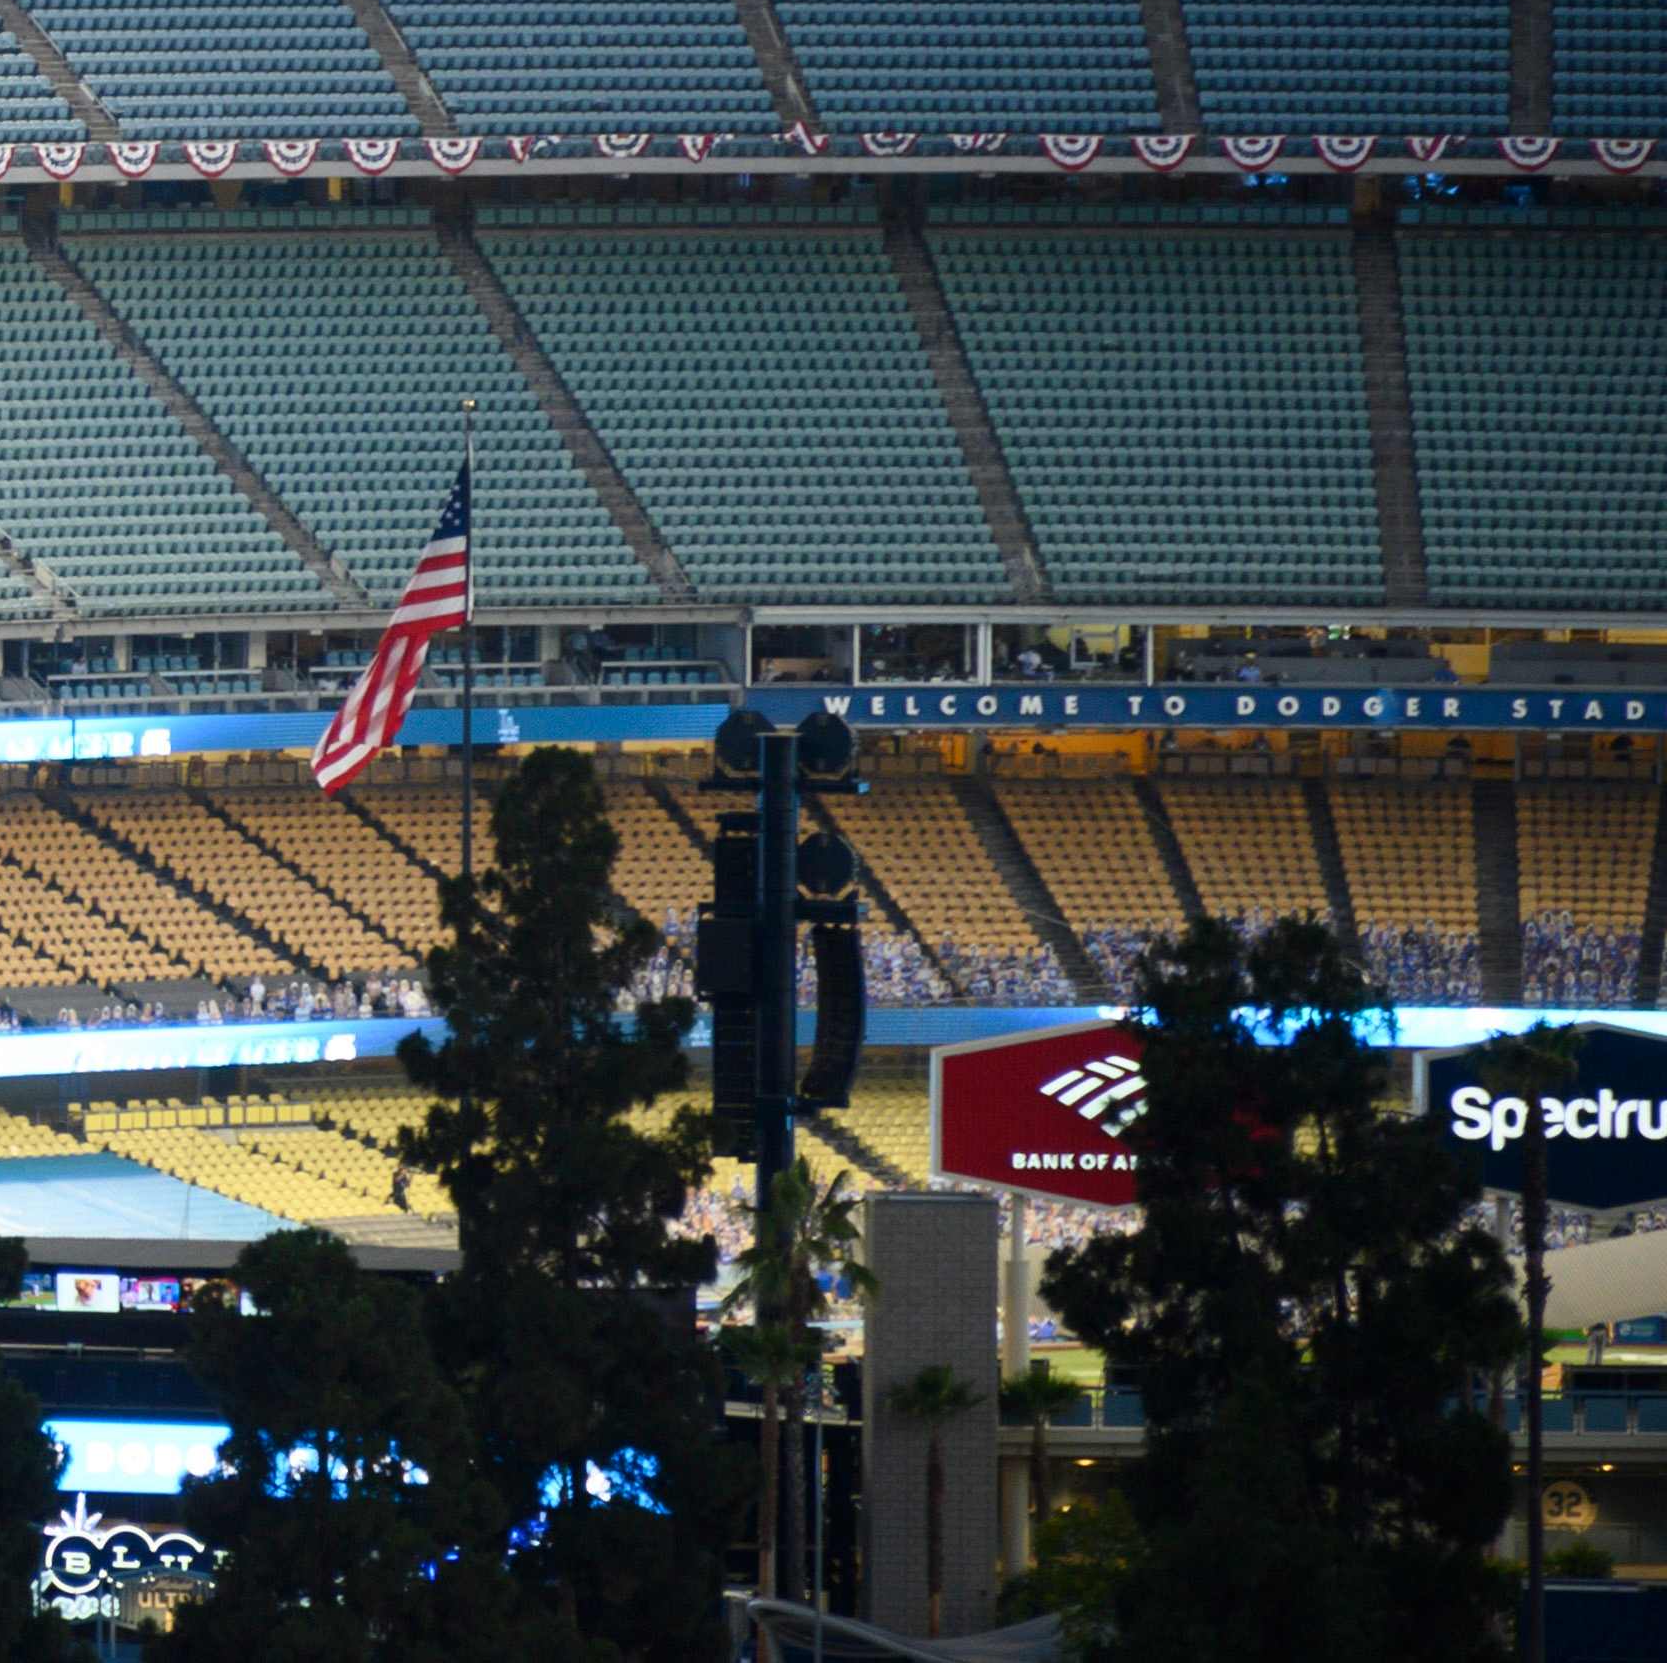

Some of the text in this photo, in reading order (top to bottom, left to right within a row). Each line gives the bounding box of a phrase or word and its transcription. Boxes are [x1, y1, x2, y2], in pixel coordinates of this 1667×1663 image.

[824, 694, 1079, 718] WELCOME
[1128, 696, 1186, 717] TO
[1237, 696, 1461, 719] DODGER
[1011, 1152, 1075, 1170] BANK
[1079, 1153, 1110, 1171] OF
[1547, 1490, 1581, 1517] 32
